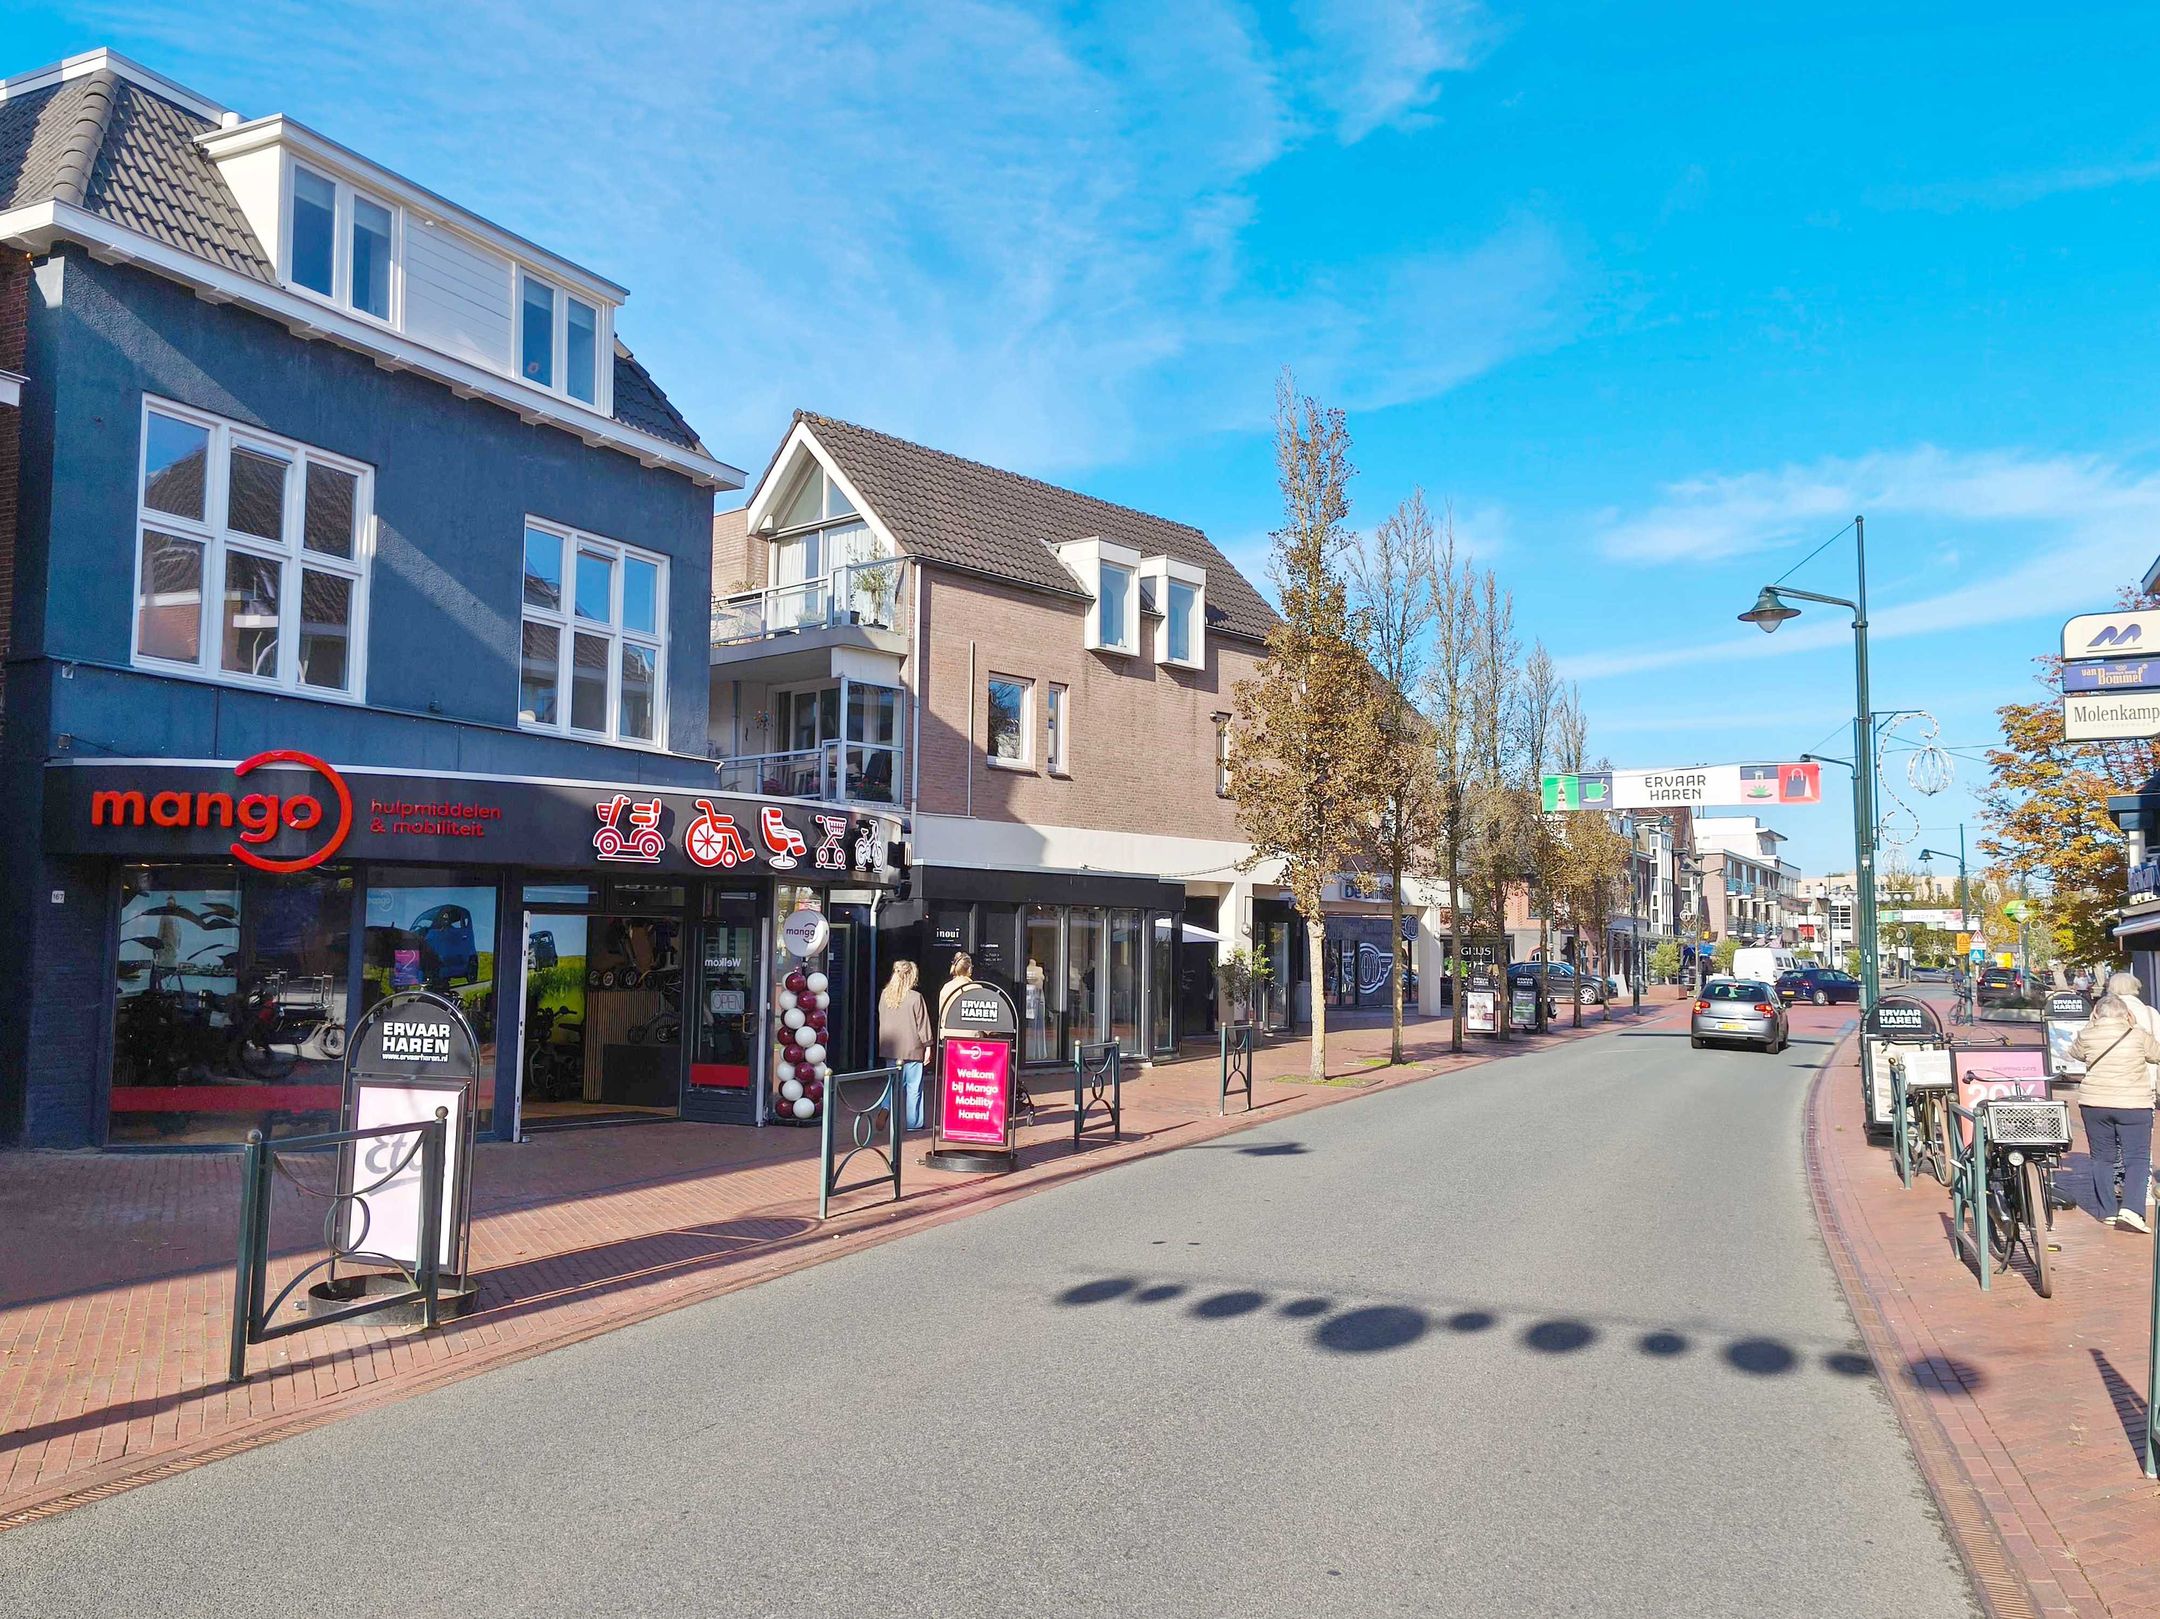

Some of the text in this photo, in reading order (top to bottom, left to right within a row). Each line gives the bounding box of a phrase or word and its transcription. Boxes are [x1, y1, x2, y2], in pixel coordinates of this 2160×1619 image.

[2081, 663, 2143, 685] van Bommel
[2074, 704, 2160, 723] Molenkamp
[1645, 775, 1706, 788] ERVAAR
[1650, 788, 1702, 801] HAREN
[371, 799, 502, 819] hulpmiddelen
[91, 790, 323, 843] mango
[369, 817, 485, 838] & mobiliteit
[786, 926, 815, 938] mango
[961, 1000, 998, 1009] ERVAAR
[961, 1008, 998, 1018] HAREN
[1879, 1009, 1921, 1017] ERVAAR
[1880, 1016, 1922, 1025] HAREN
[383, 1022, 450, 1037] ERVAAR
[382, 1036, 450, 1053] HAREN
[957, 1068, 995, 1080] Welkom
[951, 1081, 999, 1096] bij Mango
[955, 1096, 994, 1109] Mobility
[958, 1109, 990, 1121] Haren!
